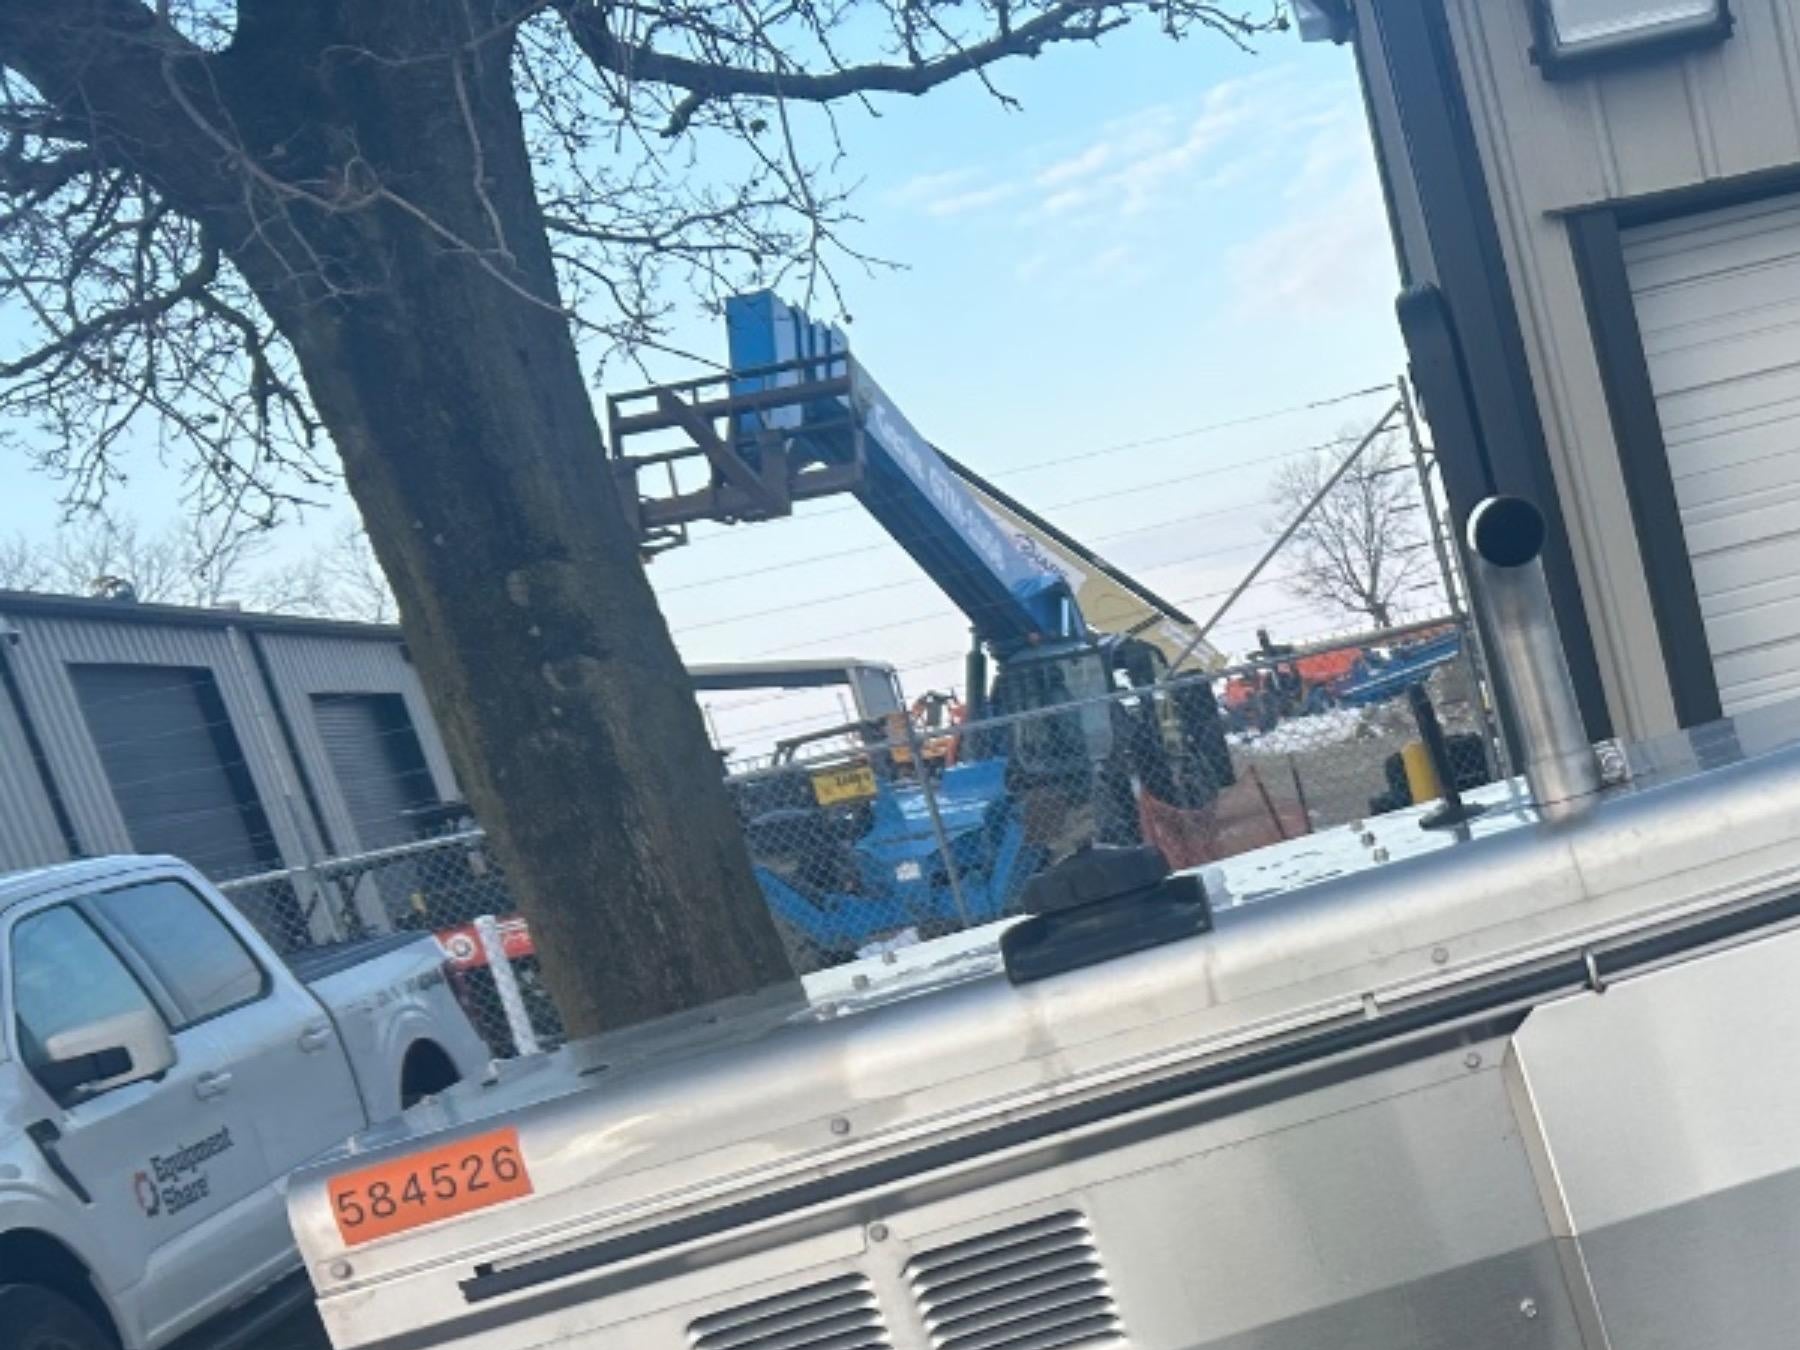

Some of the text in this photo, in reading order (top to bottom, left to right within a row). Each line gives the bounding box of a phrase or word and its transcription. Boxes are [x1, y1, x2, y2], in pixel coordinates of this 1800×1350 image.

[150, 1125, 233, 1182] Equipment
[161, 1177, 210, 1216] Share
[337, 1146, 519, 1228] 584526
